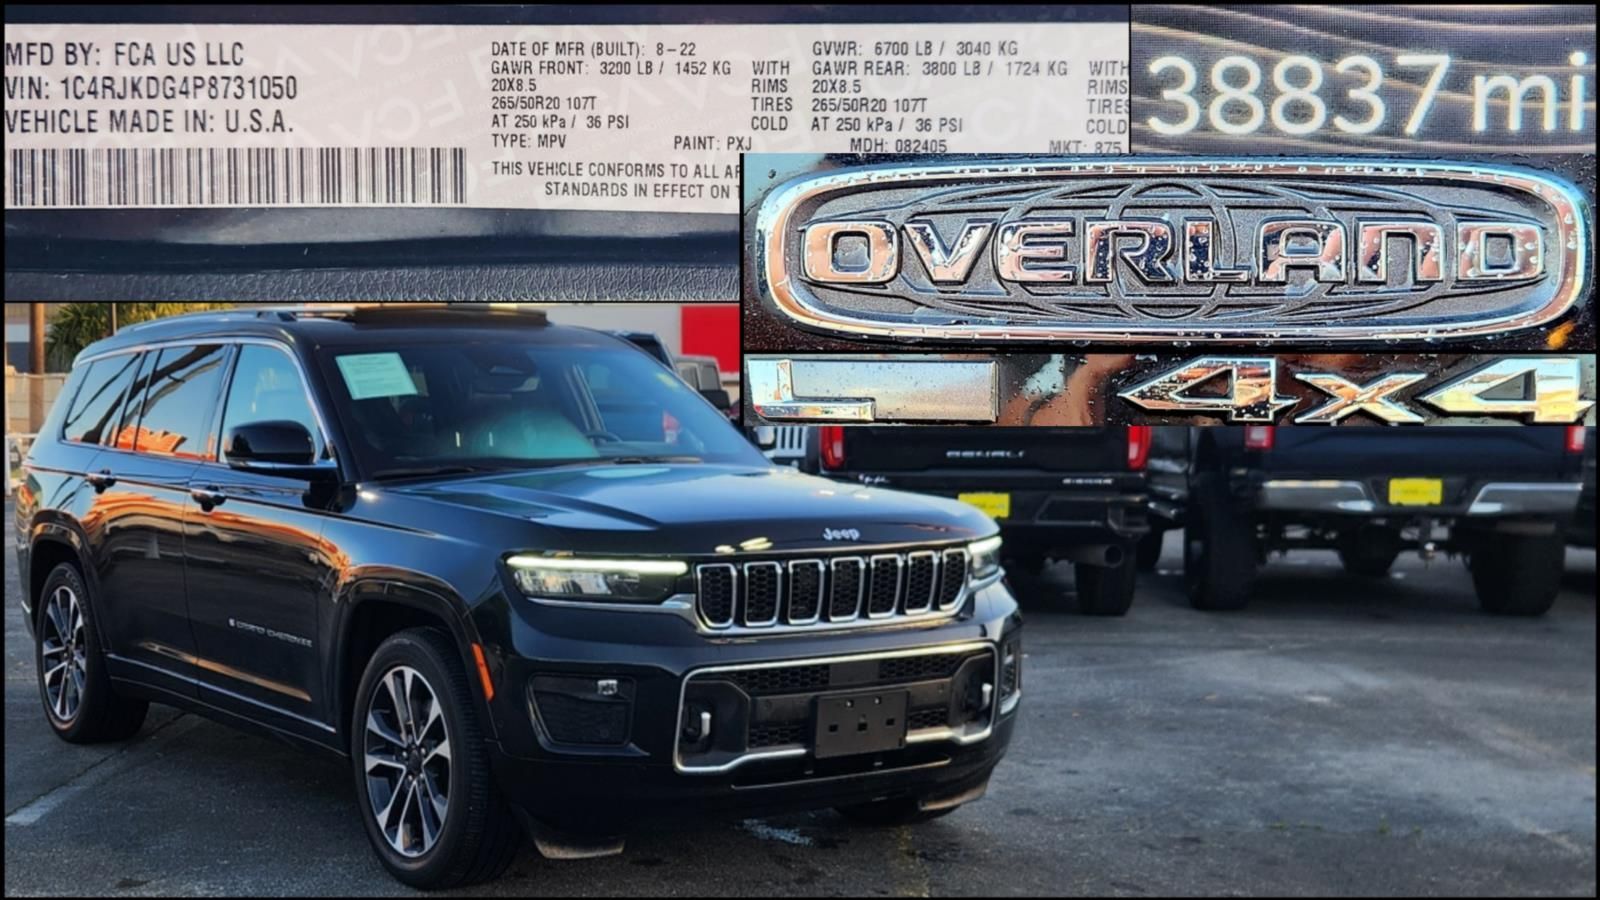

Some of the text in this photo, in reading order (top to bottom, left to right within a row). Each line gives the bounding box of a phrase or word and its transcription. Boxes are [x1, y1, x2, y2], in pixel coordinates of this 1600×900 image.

[5, 41, 244, 67] MFD BY: FCA US LLC
[491, 41, 527, 57] DATE
[531, 41, 549, 57] OF
[555, 41, 585, 56] MFR
[591, 41, 645, 59] (BUILT):
[812, 40, 1018, 57] GVWR: 6700 LB / 3040 KG
[491, 60, 790, 76] GAWR FRONT: 3200 LB / 1452 KG WITH
[812, 60, 1129, 77] GAWR REAR: 3800 LB / 1724 KG WITH
[5, 75, 297, 100] VIN: 1C4RJKDG4P8731050
[491, 77, 788, 94] 20X8.5 RIMS
[812, 78, 1128, 95] 20X8.5 RIMS
[1147, 51, 1589, 136] 38837 mi
[491, 95, 793, 112] 265/50R20 107T TIRES
[811, 97, 887, 113] 265/50R20
[894, 97, 928, 113] 107T
[5, 108, 293, 134] VEHICLE MADE IN: U.S.A.
[491, 113, 789, 131] AT 250 kPa / 36 PSI COLD
[811, 116, 1128, 135] AT 250 kPa / 36 PSI COLD
[491, 133, 752, 152] TYPE: MPV PAINT: PXJ
[850, 137, 889, 153] MDH:
[895, 138, 948, 153] 082405
[1095, 141, 1123, 153] 875
[492, 160, 523, 176] THIS
[527, 161, 583, 177] VEHICLE
[588, 162, 665, 178] CONFORMS
[670, 163, 688, 179] TO
[693, 163, 720, 179] ALL
[544, 181, 628, 197] STANDARDS
[634, 183, 648, 197] IN
[653, 183, 705, 199] EFFECT
[710, 184, 730, 199] ON
[800, 218, 1550, 286] OVERLAND
[1116, 356, 1595, 423] 4x4
[823, 527, 861, 542] Jeep
